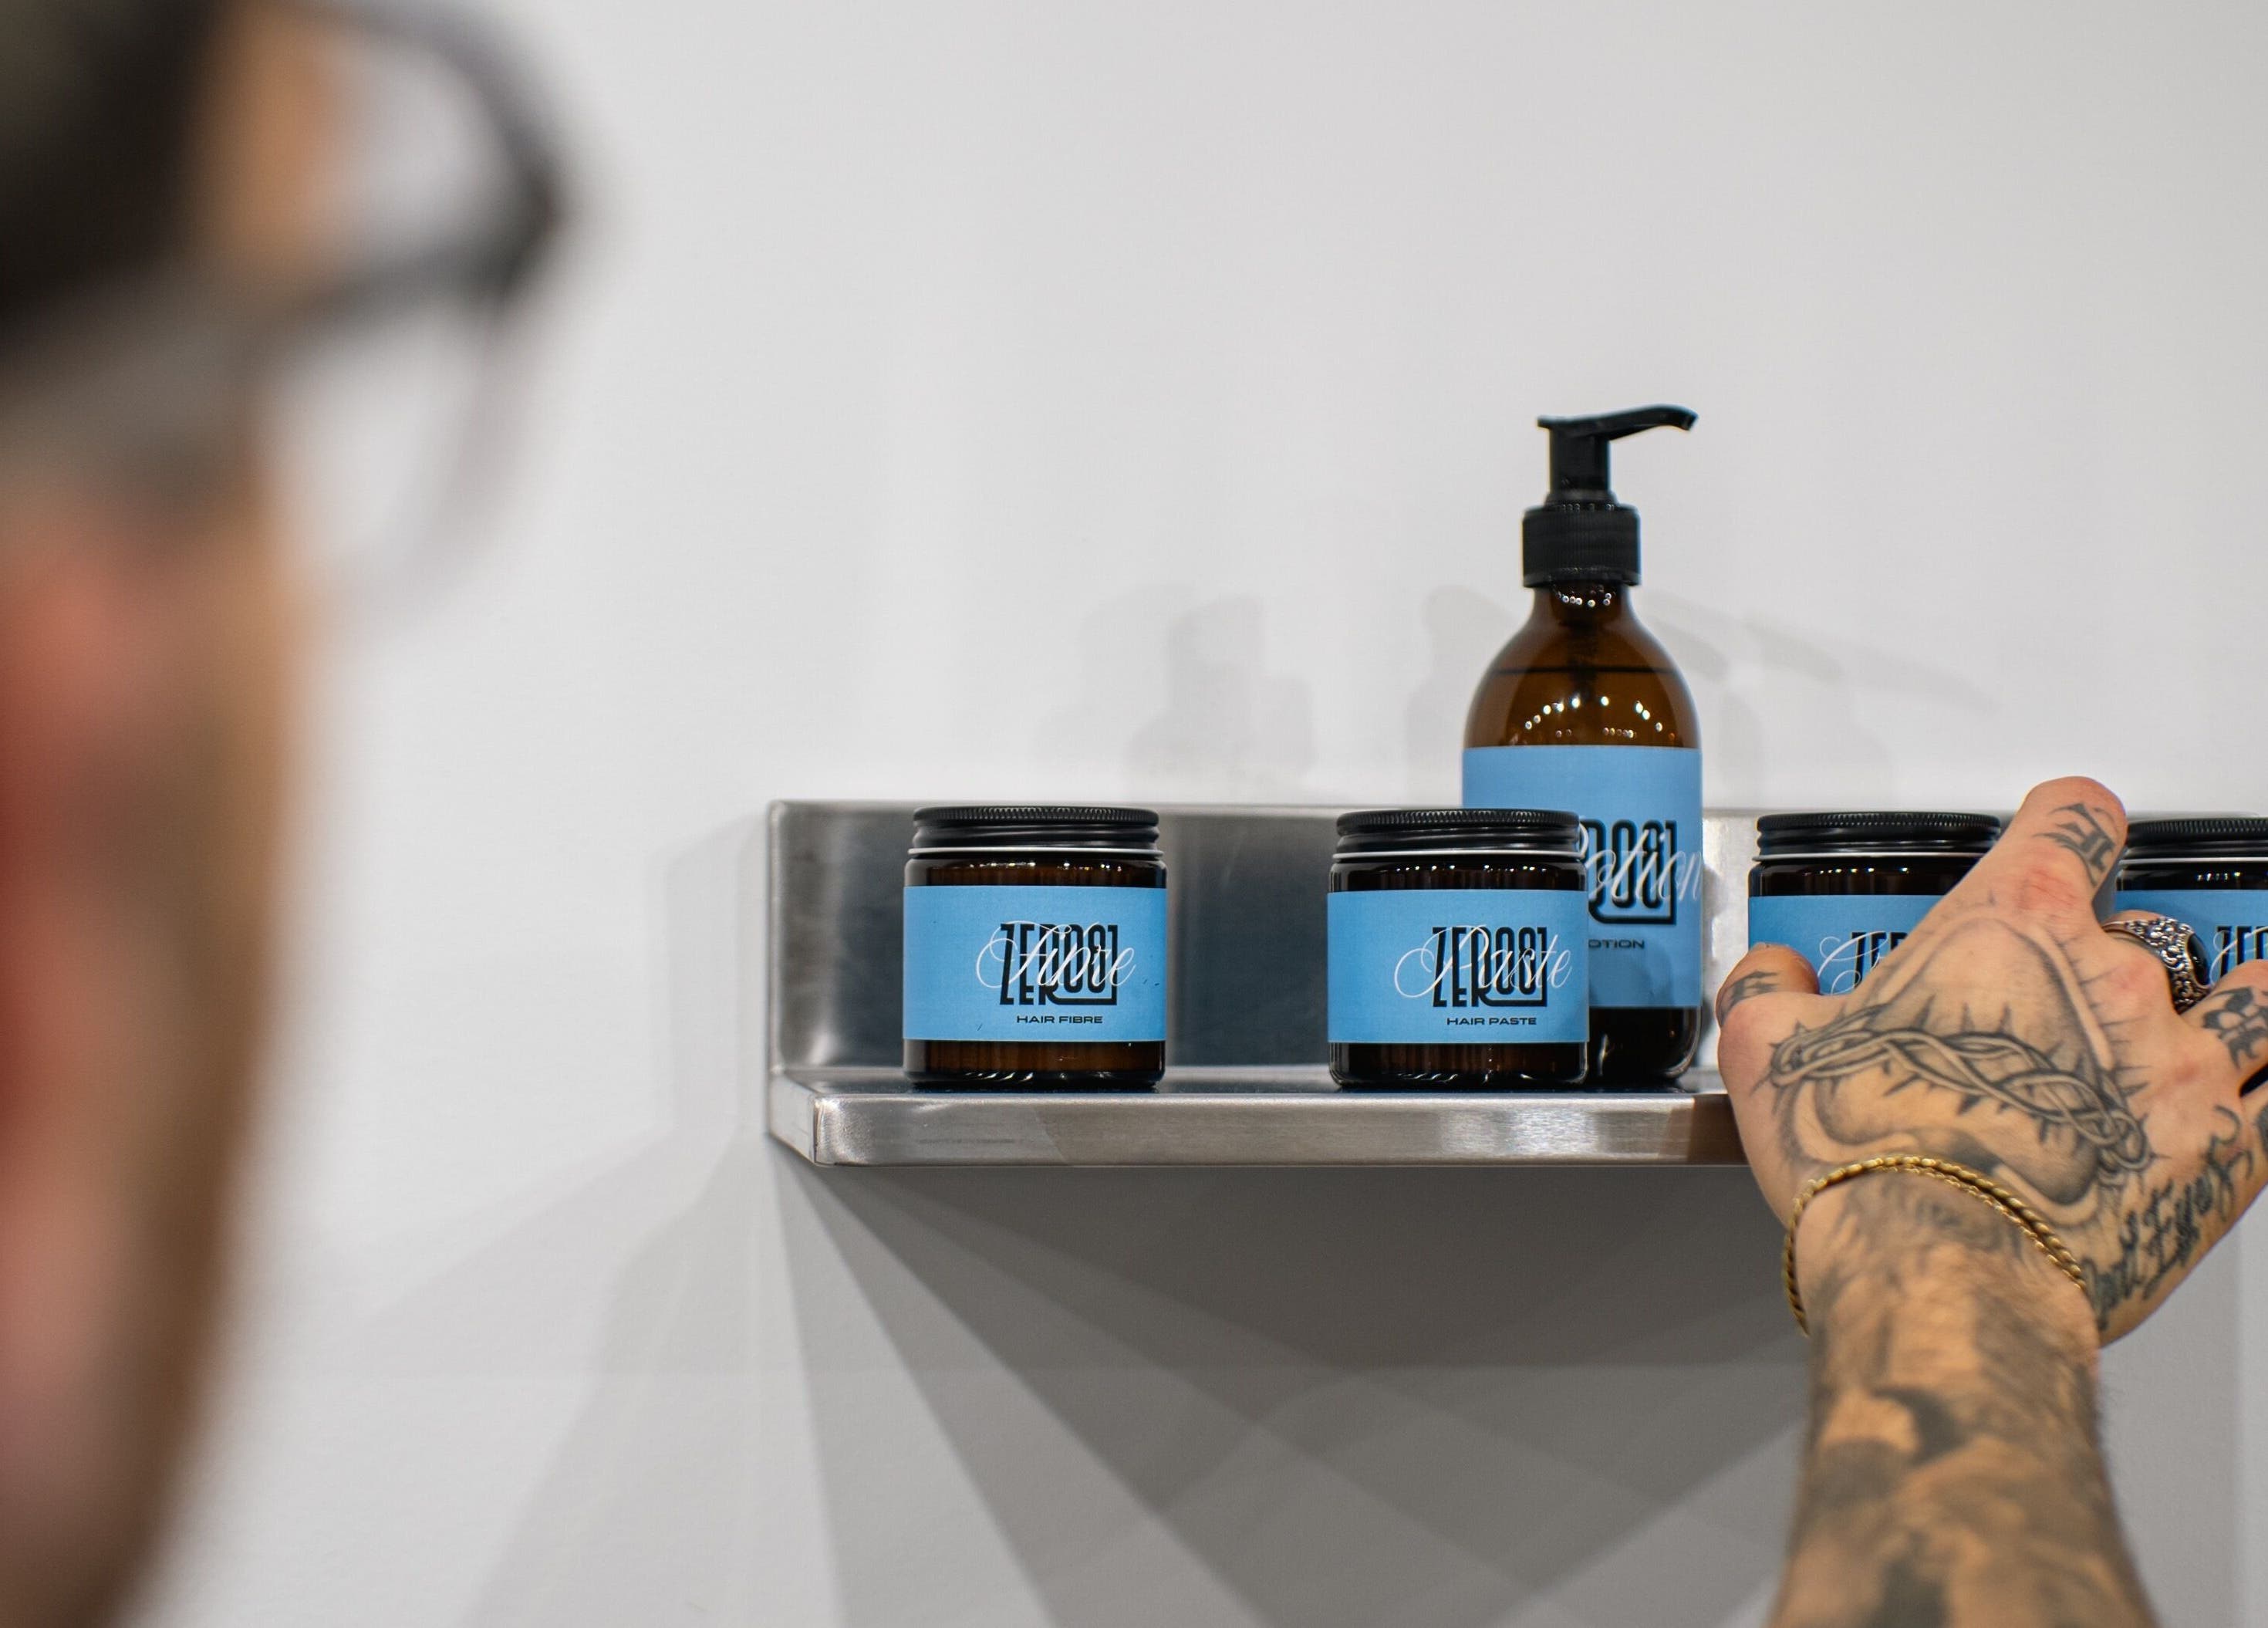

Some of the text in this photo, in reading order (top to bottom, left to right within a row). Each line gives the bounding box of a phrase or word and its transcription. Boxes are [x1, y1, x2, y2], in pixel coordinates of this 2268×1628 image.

[1579, 821, 1702, 901] otion
[1579, 819, 1677, 925] RO81
[976, 920, 1136, 988] Fibre
[1394, 924, 1573, 998] Paste
[1588, 940, 1645, 949] OTION
[1016, 1015, 1103, 1024] HAIR FIBRE
[1446, 1017, 1537, 1025] HAIR PASTE
